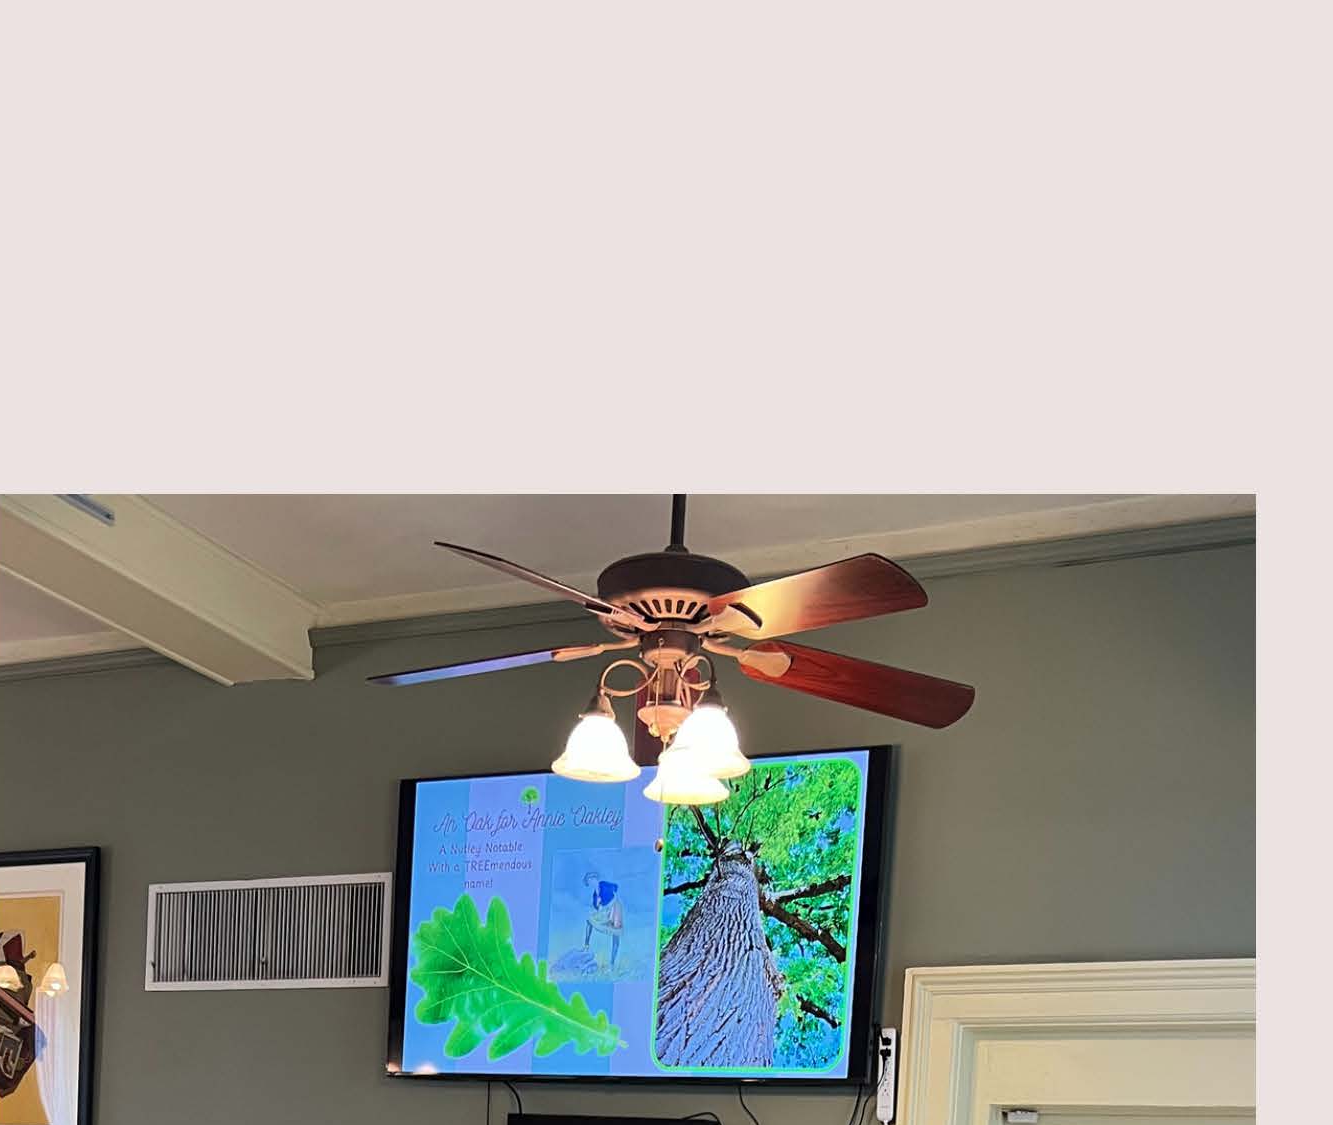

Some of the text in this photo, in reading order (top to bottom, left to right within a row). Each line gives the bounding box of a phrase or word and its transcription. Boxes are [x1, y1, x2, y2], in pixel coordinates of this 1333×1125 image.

[462, 810, 494, 833] Oak
[491, 810, 518, 837] for
[521, 808, 566, 831] Annie
[571, 804, 623, 831] Oakley
[439, 841, 523, 857] A Nutley Notable
[428, 859, 532, 873] With a TREEmendous
[464, 879, 494, 889] name!
